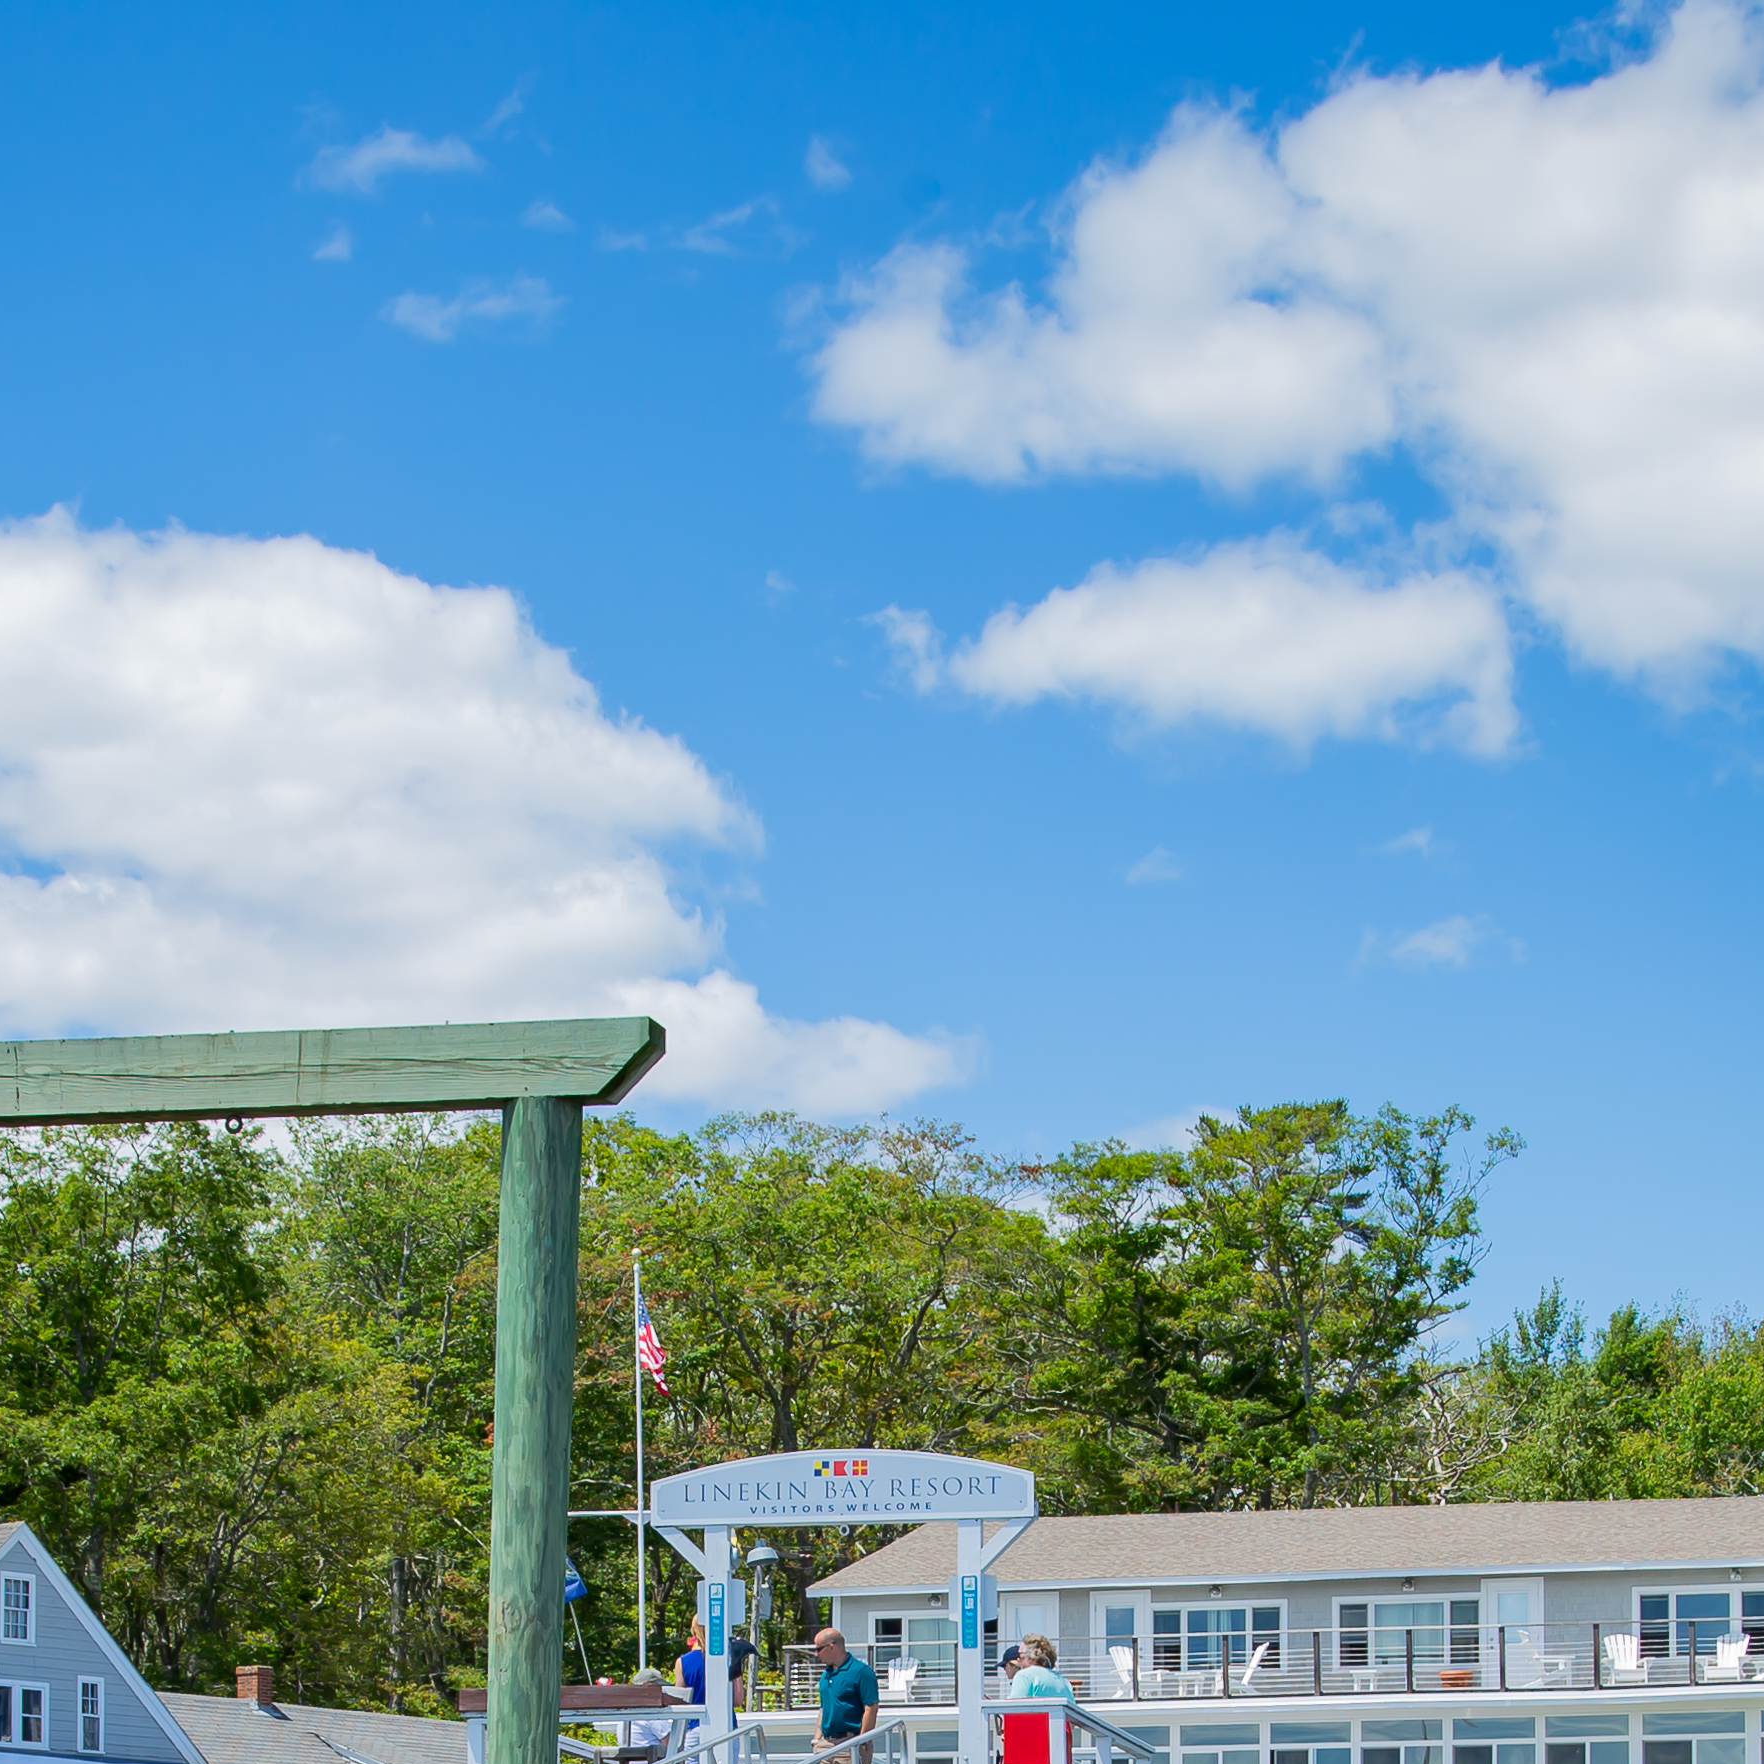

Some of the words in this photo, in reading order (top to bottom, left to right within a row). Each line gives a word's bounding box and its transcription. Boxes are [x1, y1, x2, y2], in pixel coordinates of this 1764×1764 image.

[684, 1481, 807, 1503] LINEKIN
[824, 1479, 875, 1500] BAY
[890, 1476, 1002, 1497] RESORT
[750, 1504, 835, 1514] VISITORS
[846, 1502, 932, 1512] WELCOME
